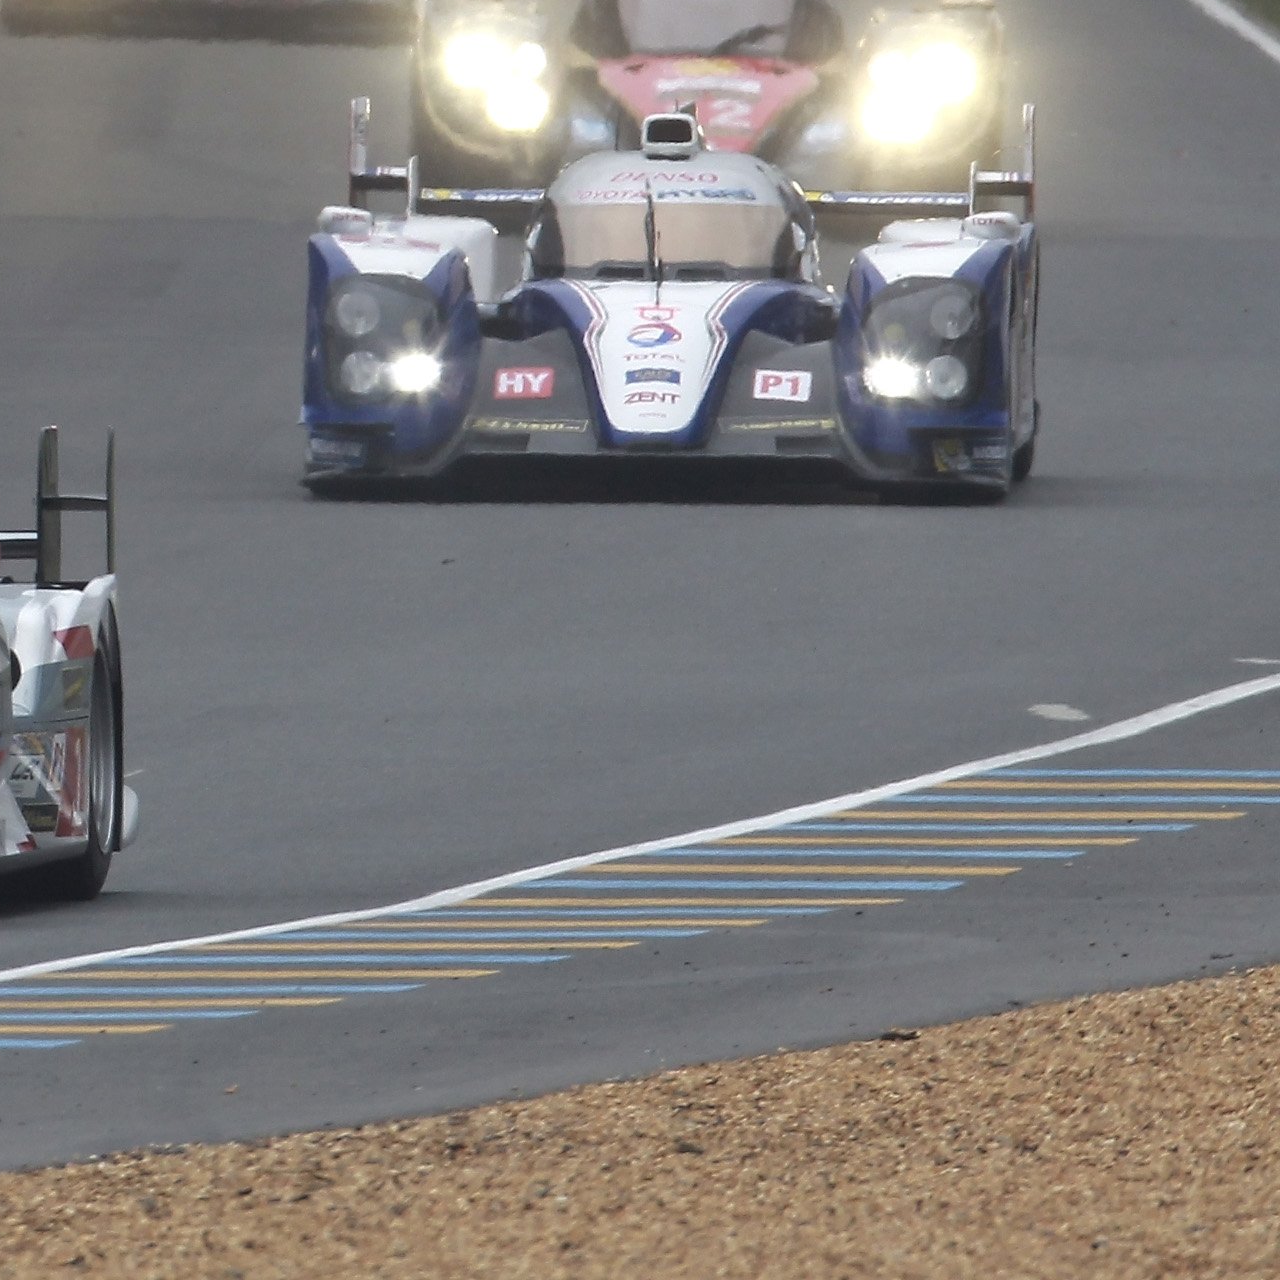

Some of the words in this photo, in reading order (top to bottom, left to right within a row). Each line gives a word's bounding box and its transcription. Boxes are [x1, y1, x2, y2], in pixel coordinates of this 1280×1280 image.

[496, 371, 549, 394] HY
[759, 373, 803, 397] P1
[624, 391, 681, 404] ZENT
